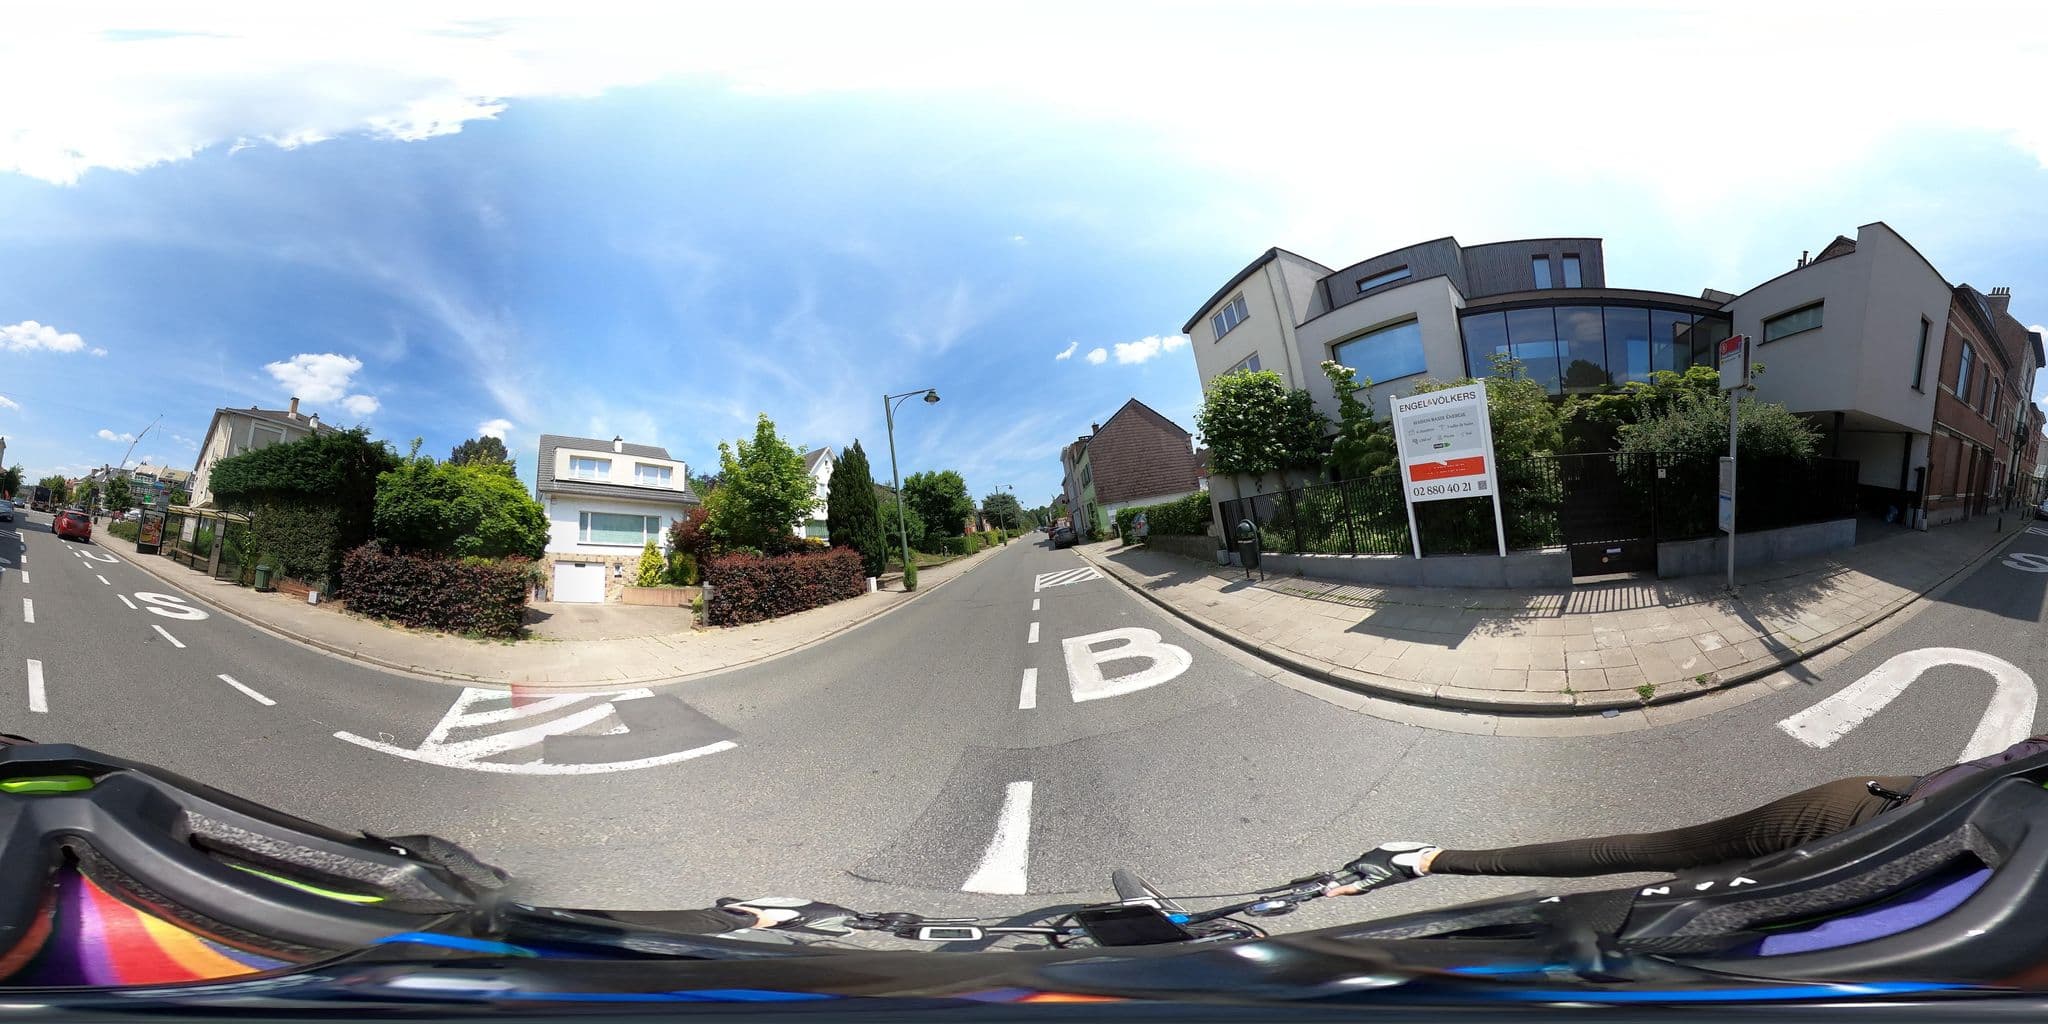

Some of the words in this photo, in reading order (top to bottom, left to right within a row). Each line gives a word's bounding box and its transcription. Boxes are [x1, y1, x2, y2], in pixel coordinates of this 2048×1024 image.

[1413, 486, 1426, 496] 02
[1426, 484, 1445, 495] 880
[1447, 483, 1460, 493] 40
[1462, 482, 1472, 492] 21
[134, 591, 210, 621] S
[1061, 626, 1193, 703] B
